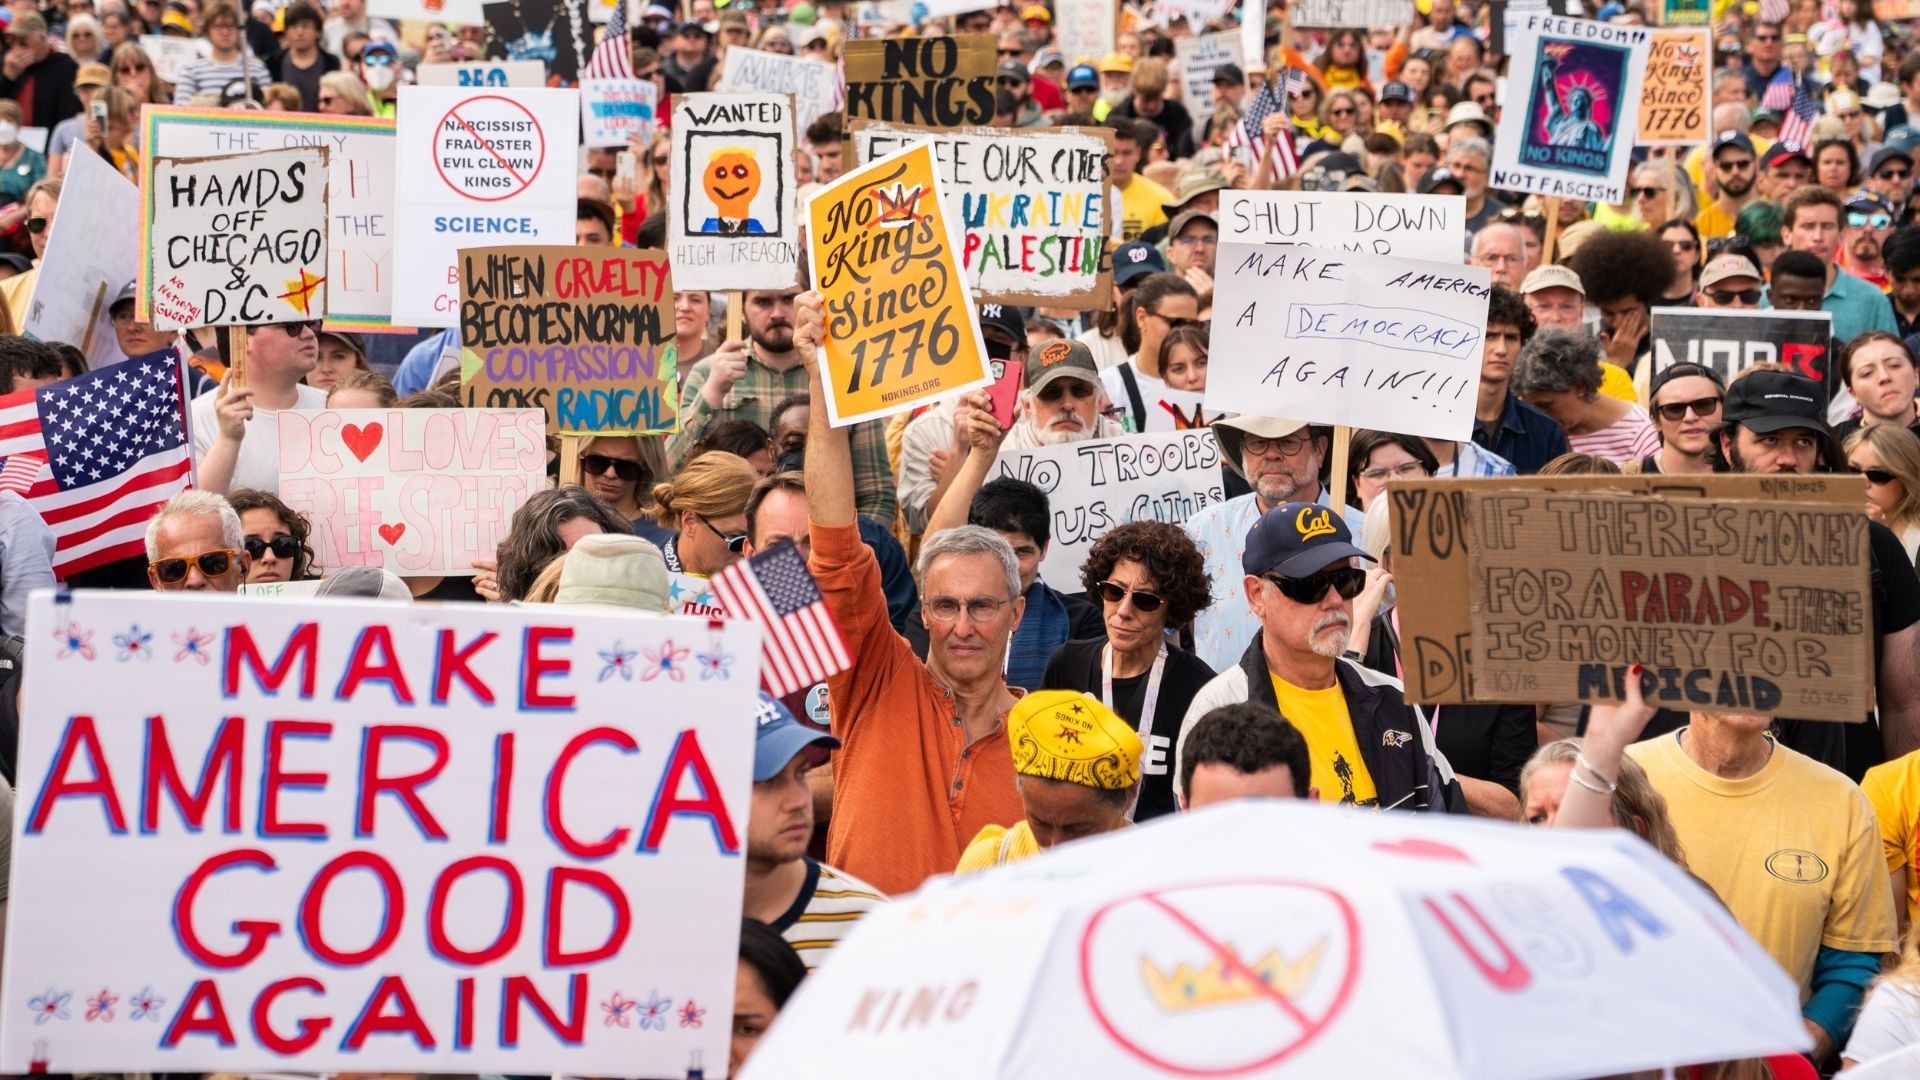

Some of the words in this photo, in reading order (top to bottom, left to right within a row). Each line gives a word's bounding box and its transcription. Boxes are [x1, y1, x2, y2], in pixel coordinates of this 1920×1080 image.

[881, 36, 958, 79] NO
[684, 103, 782, 127] WANTED
[846, 76, 996, 127] KINGS
[1644, 106, 1701, 132] 1776
[209, 132, 260, 150] THE
[445, 120, 533, 133] NARCISSIST
[445, 139, 532, 151] FRAUDSTER
[443, 158, 474, 169] EVIL
[478, 158, 533, 170] CLOWN
[983, 142, 1044, 187] OUR
[1526, 145, 1551, 163] NO
[1555, 149, 1606, 170] KINGS
[171, 161, 306, 208] HANDS
[464, 176, 511, 188] KINGS
[823, 163, 907, 245] No
[1494, 170, 1535, 190] NOT
[1539, 176, 1620, 201] FASCISM
[212, 210, 267, 232] OFF
[335, 215, 387, 236] THE
[434, 217, 538, 237] SCIENCE,
[962, 191, 1103, 229] UKRAINE
[1233, 199, 1322, 236] SHUT
[1353, 200, 1446, 233] DOWN
[168, 229, 321, 268] CHICAGO
[676, 244, 715, 265] HIGH
[728, 241, 797, 264] TREASON
[821, 214, 942, 288] Kings
[962, 229, 1112, 278] PALESTINE
[225, 267, 250, 290] &
[465, 254, 545, 300] WHEN
[555, 257, 670, 302] CRUELTY
[1235, 252, 1345, 281] MAKE
[1385, 271, 1490, 300] AMERICA
[204, 284, 274, 324] D.C.
[829, 259, 948, 340] Since
[1236, 301, 1256, 327] A
[460, 300, 572, 348] BECOMES
[573, 303, 676, 347] NORMAL
[486, 345, 655, 384] COMPASSION
[846, 305, 960, 394] 1776
[556, 386, 676, 431] RADICAL
[881, 378, 941, 403] NOKINGS.ORG
[278, 411, 344, 474] DC
[387, 410, 546, 472] LOVES
[1000, 455, 1061, 494] NO
[1078, 432, 1219, 486] TROOPS
[280, 476, 384, 568] FREE
[1295, 506, 1337, 542] Cal
[1480, 496, 1530, 550] IF
[1545, 498, 1740, 558] THERE'S
[1743, 508, 1870, 566] MONEY
[1486, 566, 1575, 620] FOR
[1580, 568, 1618, 619] A
[1620, 570, 1783, 633] PARADE,
[1778, 586, 1864, 636] THERE
[222, 622, 577, 713] MAKE
[1486, 621, 1550, 662] IS
[1559, 624, 1715, 668] MONEY
[1728, 632, 1832, 678] FOR
[24, 714, 741, 860] AMERICA
[172, 848, 633, 970] GOOD
[1421, 866, 1674, 994] USA
[159, 972, 590, 1055] AGAIN
[847, 978, 980, 1035] KING
